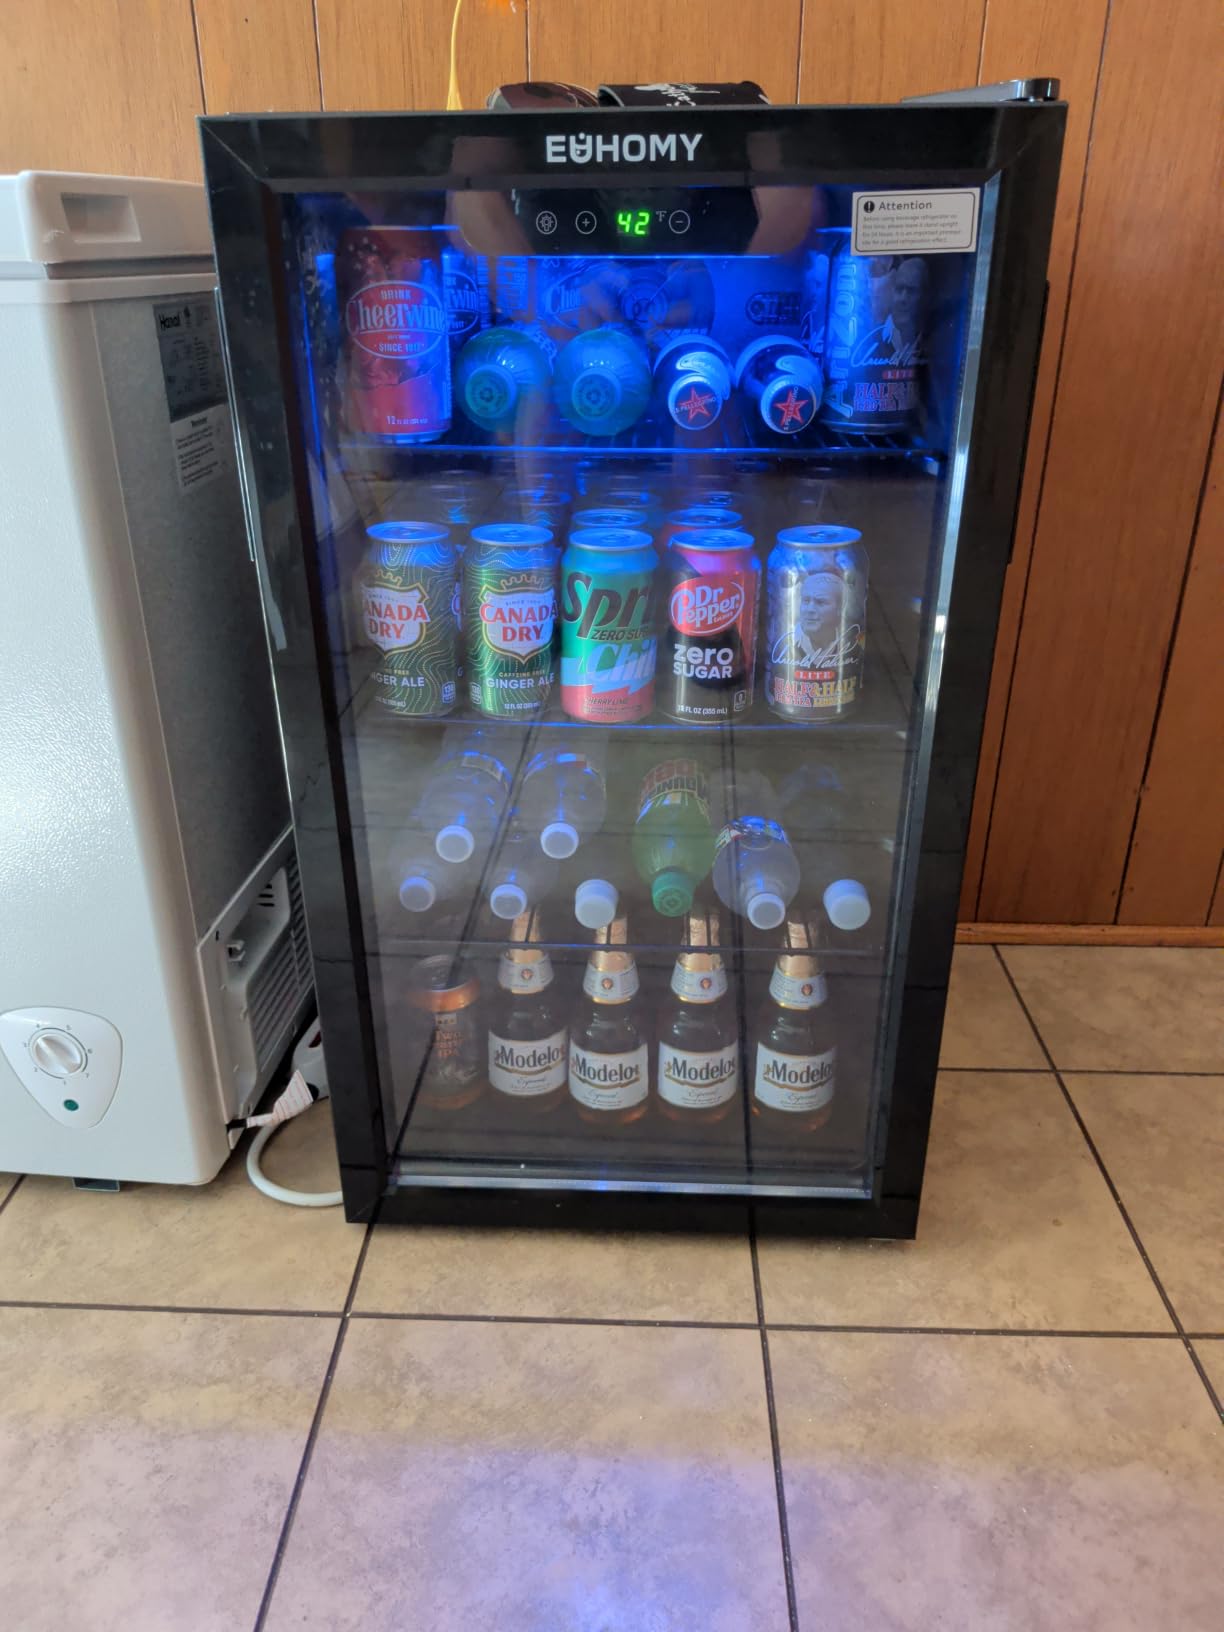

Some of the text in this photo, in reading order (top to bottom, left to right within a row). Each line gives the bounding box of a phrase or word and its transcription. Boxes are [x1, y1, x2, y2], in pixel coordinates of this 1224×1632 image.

[878, 200, 933, 211] Attention
[617, 212, 650, 235] 42
[677, 588, 741, 628] Pepper
[695, 585, 724, 608] Dr
[480, 600, 559, 625] CANADA
[369, 617, 405, 640] DRY
[502, 623, 545, 643] DRY
[591, 629, 625, 641] ZERO
[673, 643, 734, 666] zero
[401, 676, 425, 688] ALE
[485, 672, 555, 690] GINGER ALE
[673, 661, 733, 680] SUGAR
[499, 1045, 560, 1069] Modelo
[574, 1053, 635, 1083] Modelo
[671, 1056, 731, 1082] Modelo
[771, 1059, 832, 1085] Modelo
